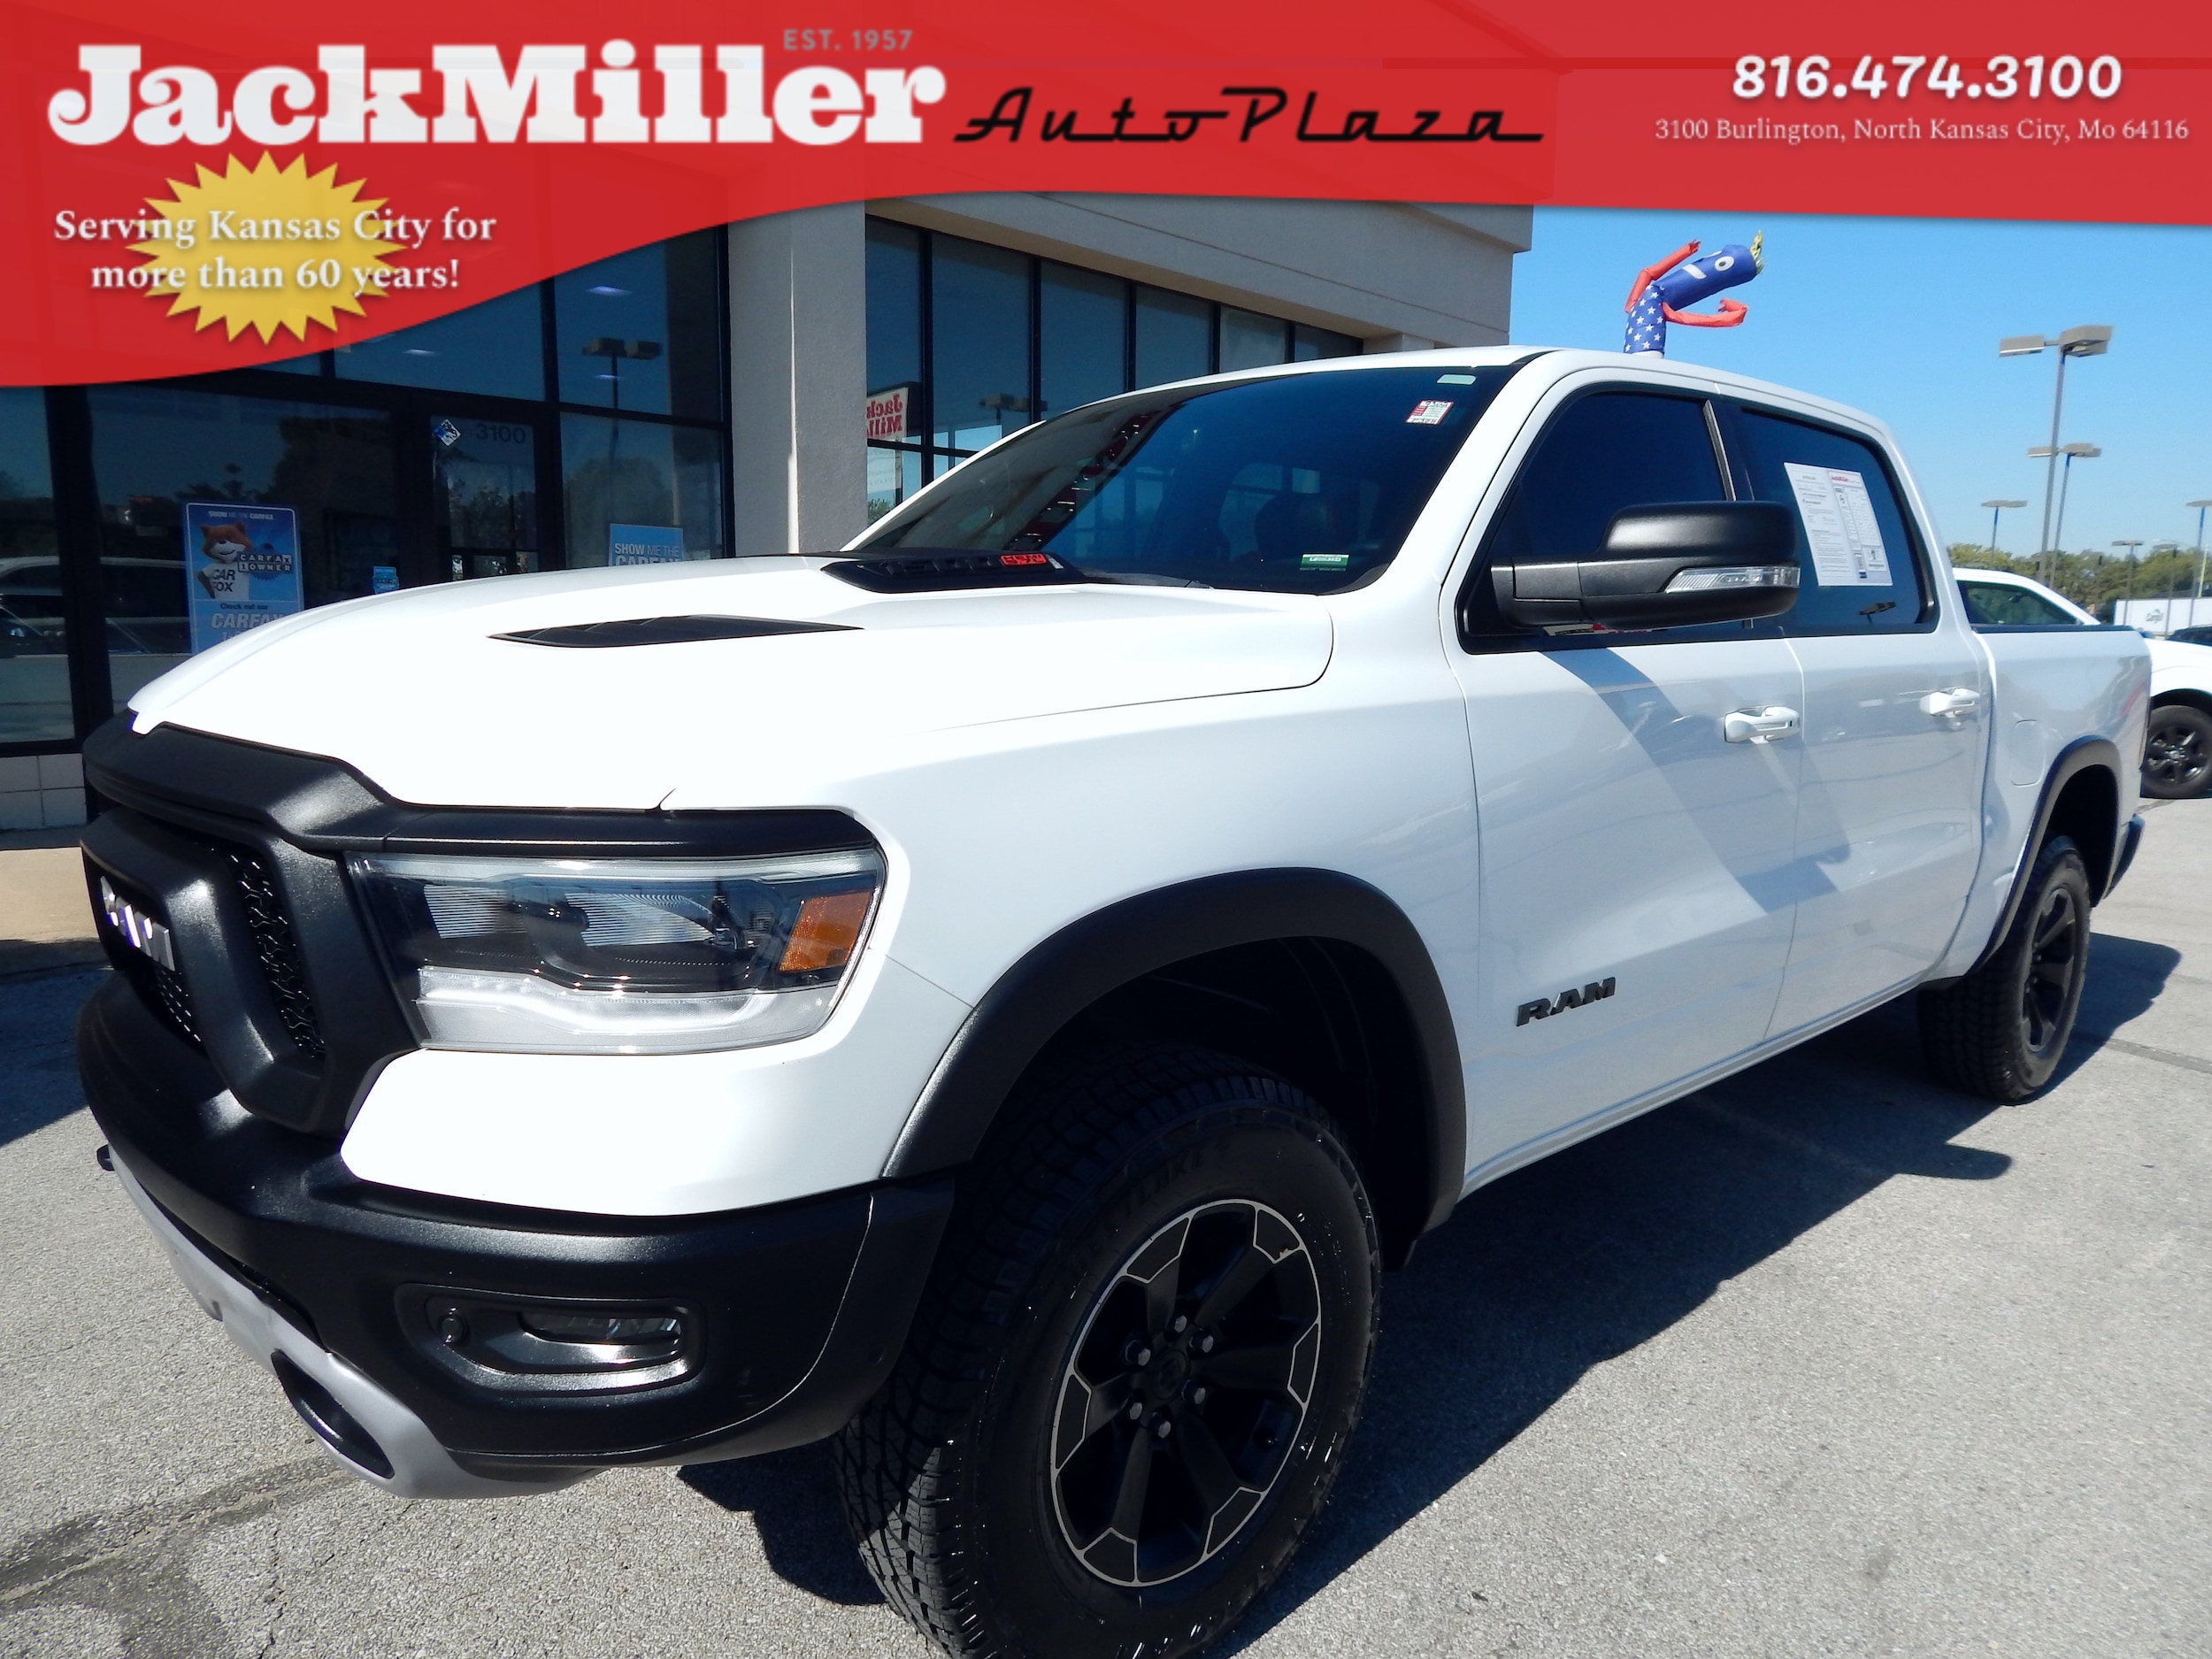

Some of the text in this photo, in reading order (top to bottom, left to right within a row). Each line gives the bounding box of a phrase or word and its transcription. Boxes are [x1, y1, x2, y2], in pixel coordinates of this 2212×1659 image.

[476, 422, 526, 444] 3100
[614, 542, 680, 557] SHOW ME THE
[240, 554, 292, 565] CARFAX
[1516, 977, 1617, 1027] RAM
